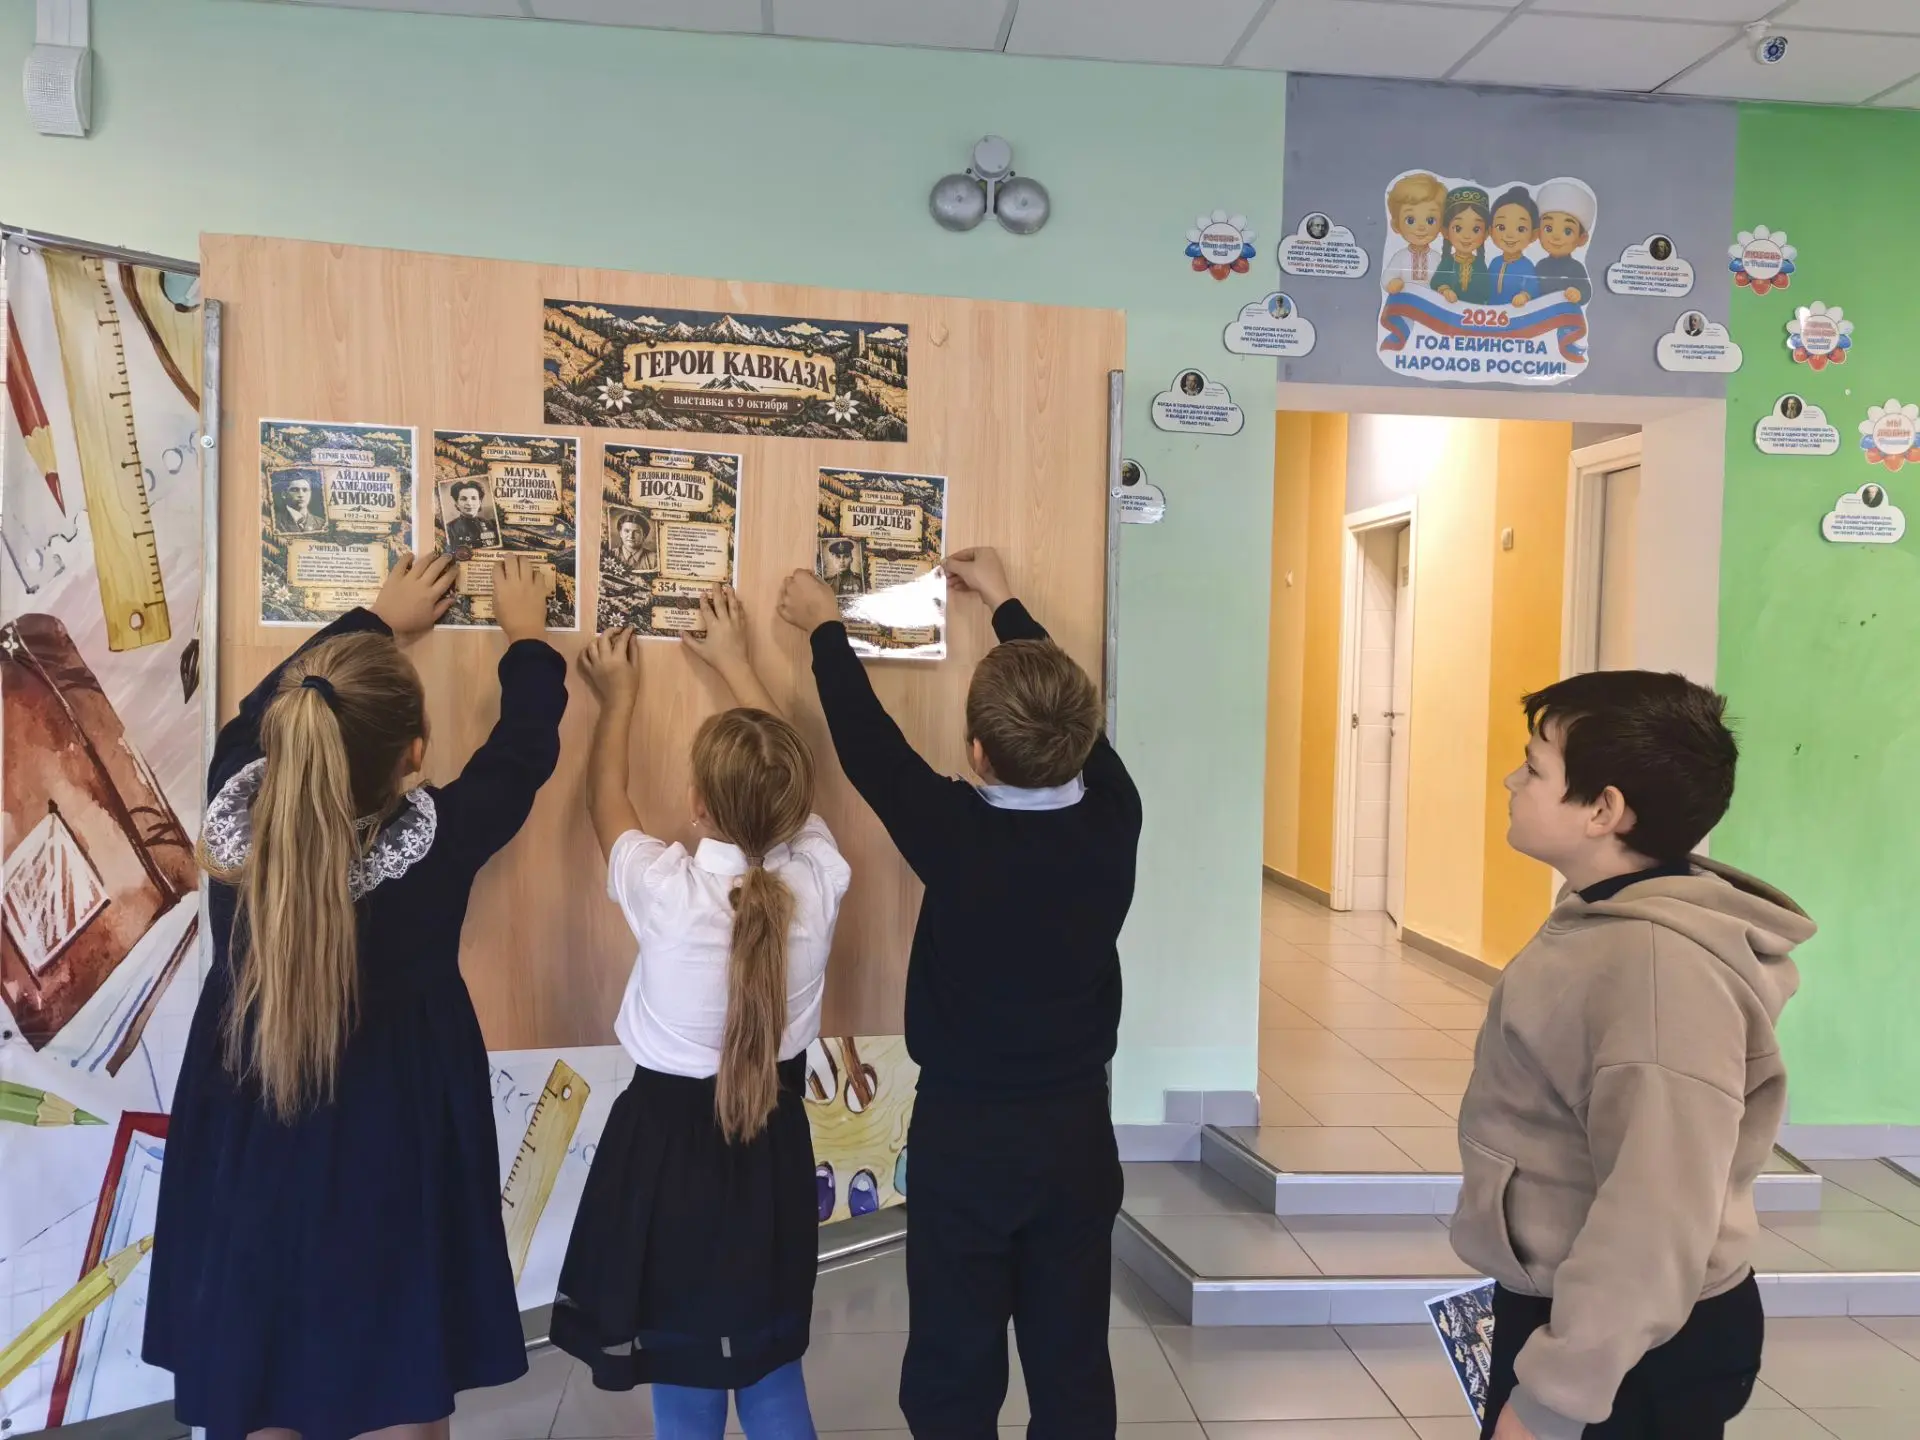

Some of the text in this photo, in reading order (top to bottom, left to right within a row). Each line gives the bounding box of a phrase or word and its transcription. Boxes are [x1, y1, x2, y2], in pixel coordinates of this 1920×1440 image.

[1462, 309, 1509, 326] 2026
[1415, 336, 1547, 354] ГОД ЕДИНСТВА
[634, 350, 831, 394] ГЕРОИ КАВКАЗА
[1395, 355, 1566, 375] НАРОДОВ РОССИИ!
[673, 395, 789, 412] выставка к 9 октября
[336, 470, 390, 482] АЙДАМИР
[504, 467, 547, 479] МАГУБА
[637, 471, 706, 486] ЕВДОКИЯ ИВАНОВНА
[330, 480, 393, 492] АХМЕДОВИЧ
[495, 477, 556, 489] ГУСЕЙНОВНА
[640, 480, 704, 501] НОСАЛЬ
[329, 491, 396, 509] АЧМИЗОВ
[494, 487, 558, 501] СЫРТЛАНОВА
[847, 504, 916, 518] ВАСИЛИЙ АНДРЕЕВИЧ
[852, 514, 912, 531] БОТЫЛЁВ
[308, 545, 340, 553] УЧИТЕЛЬ
[657, 581, 677, 592] 354
